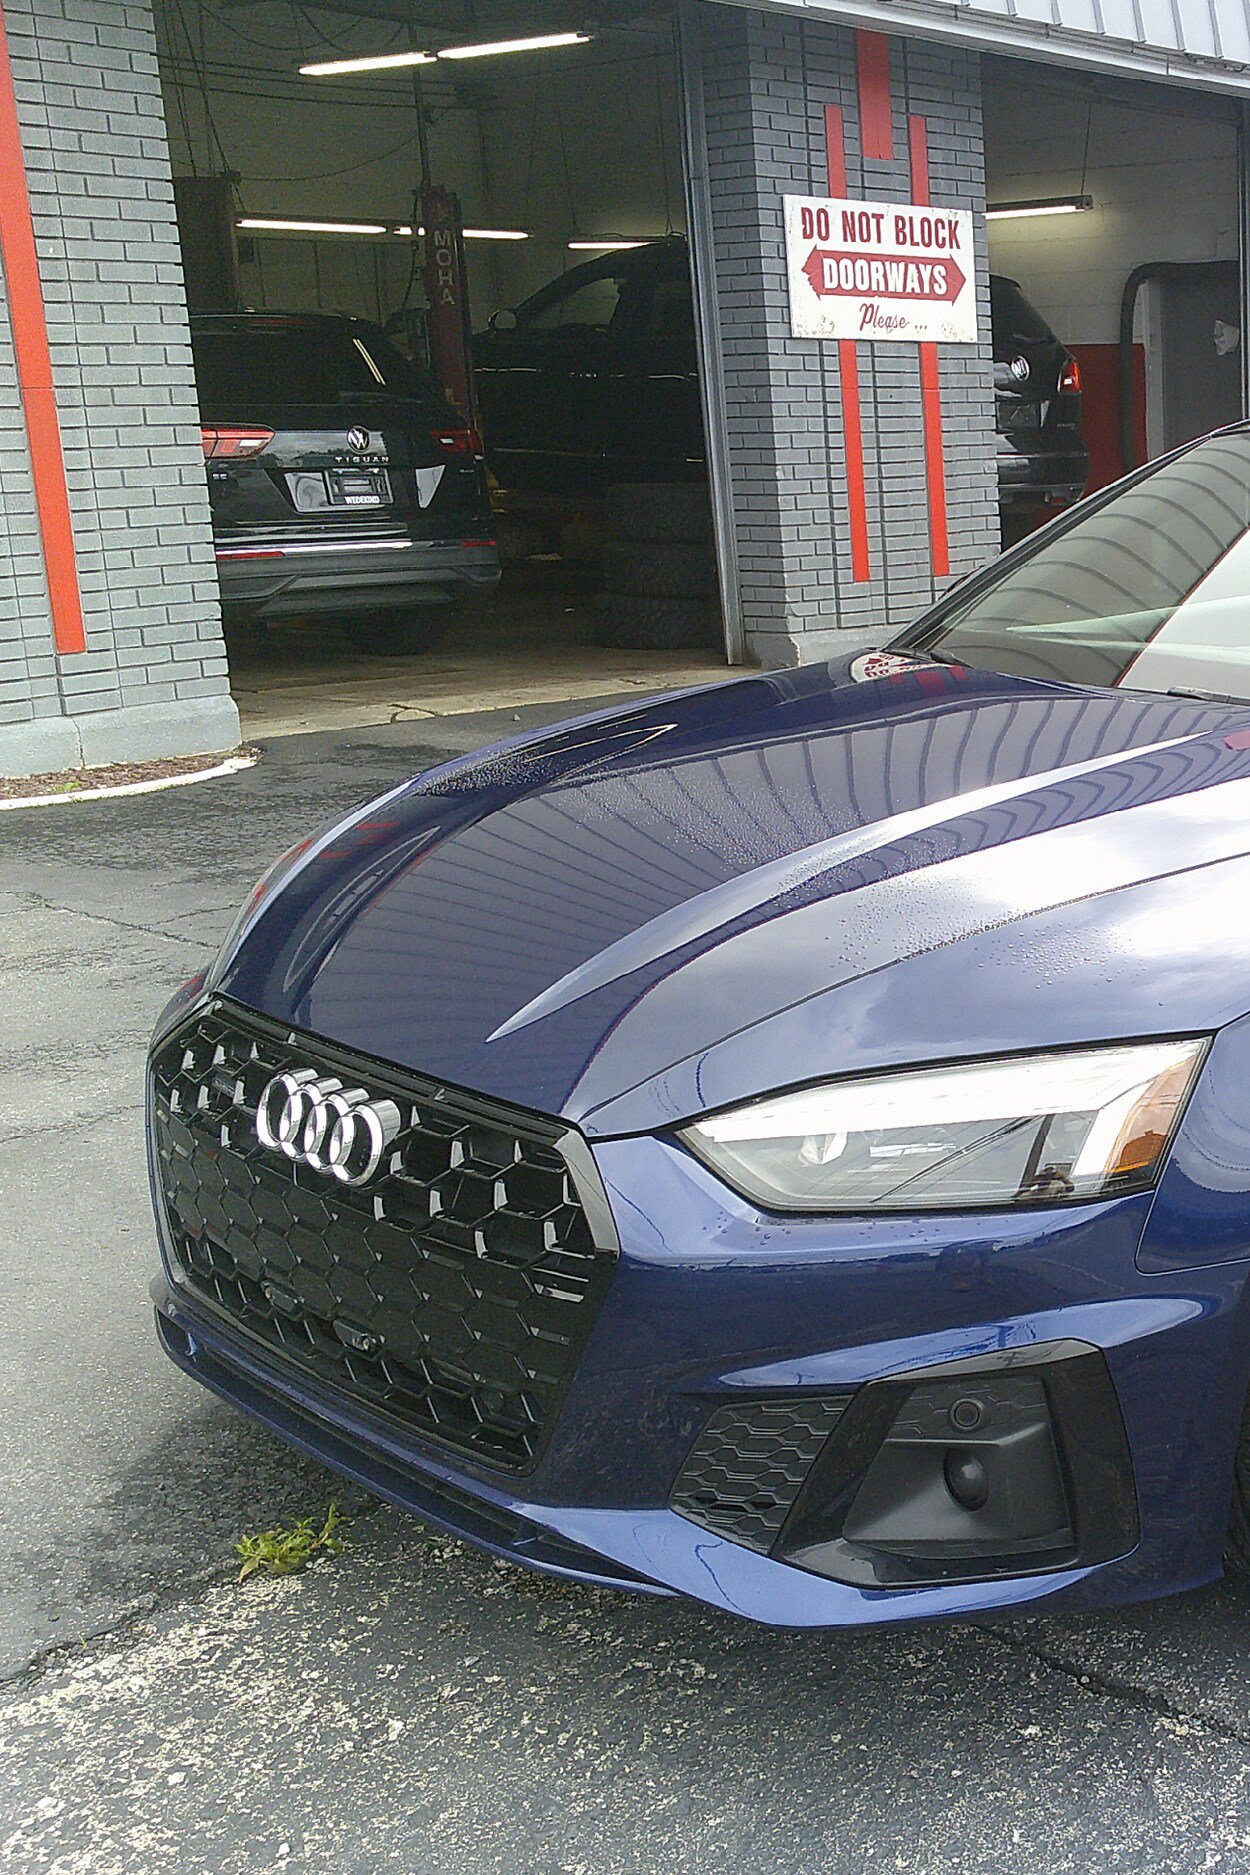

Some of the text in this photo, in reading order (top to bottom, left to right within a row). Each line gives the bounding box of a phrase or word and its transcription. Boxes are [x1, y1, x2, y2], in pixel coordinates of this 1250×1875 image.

[801, 207, 961, 249] DO NOT BLOCK
[822, 257, 948, 295] DOORWAYS
[859, 303, 910, 331] Please
